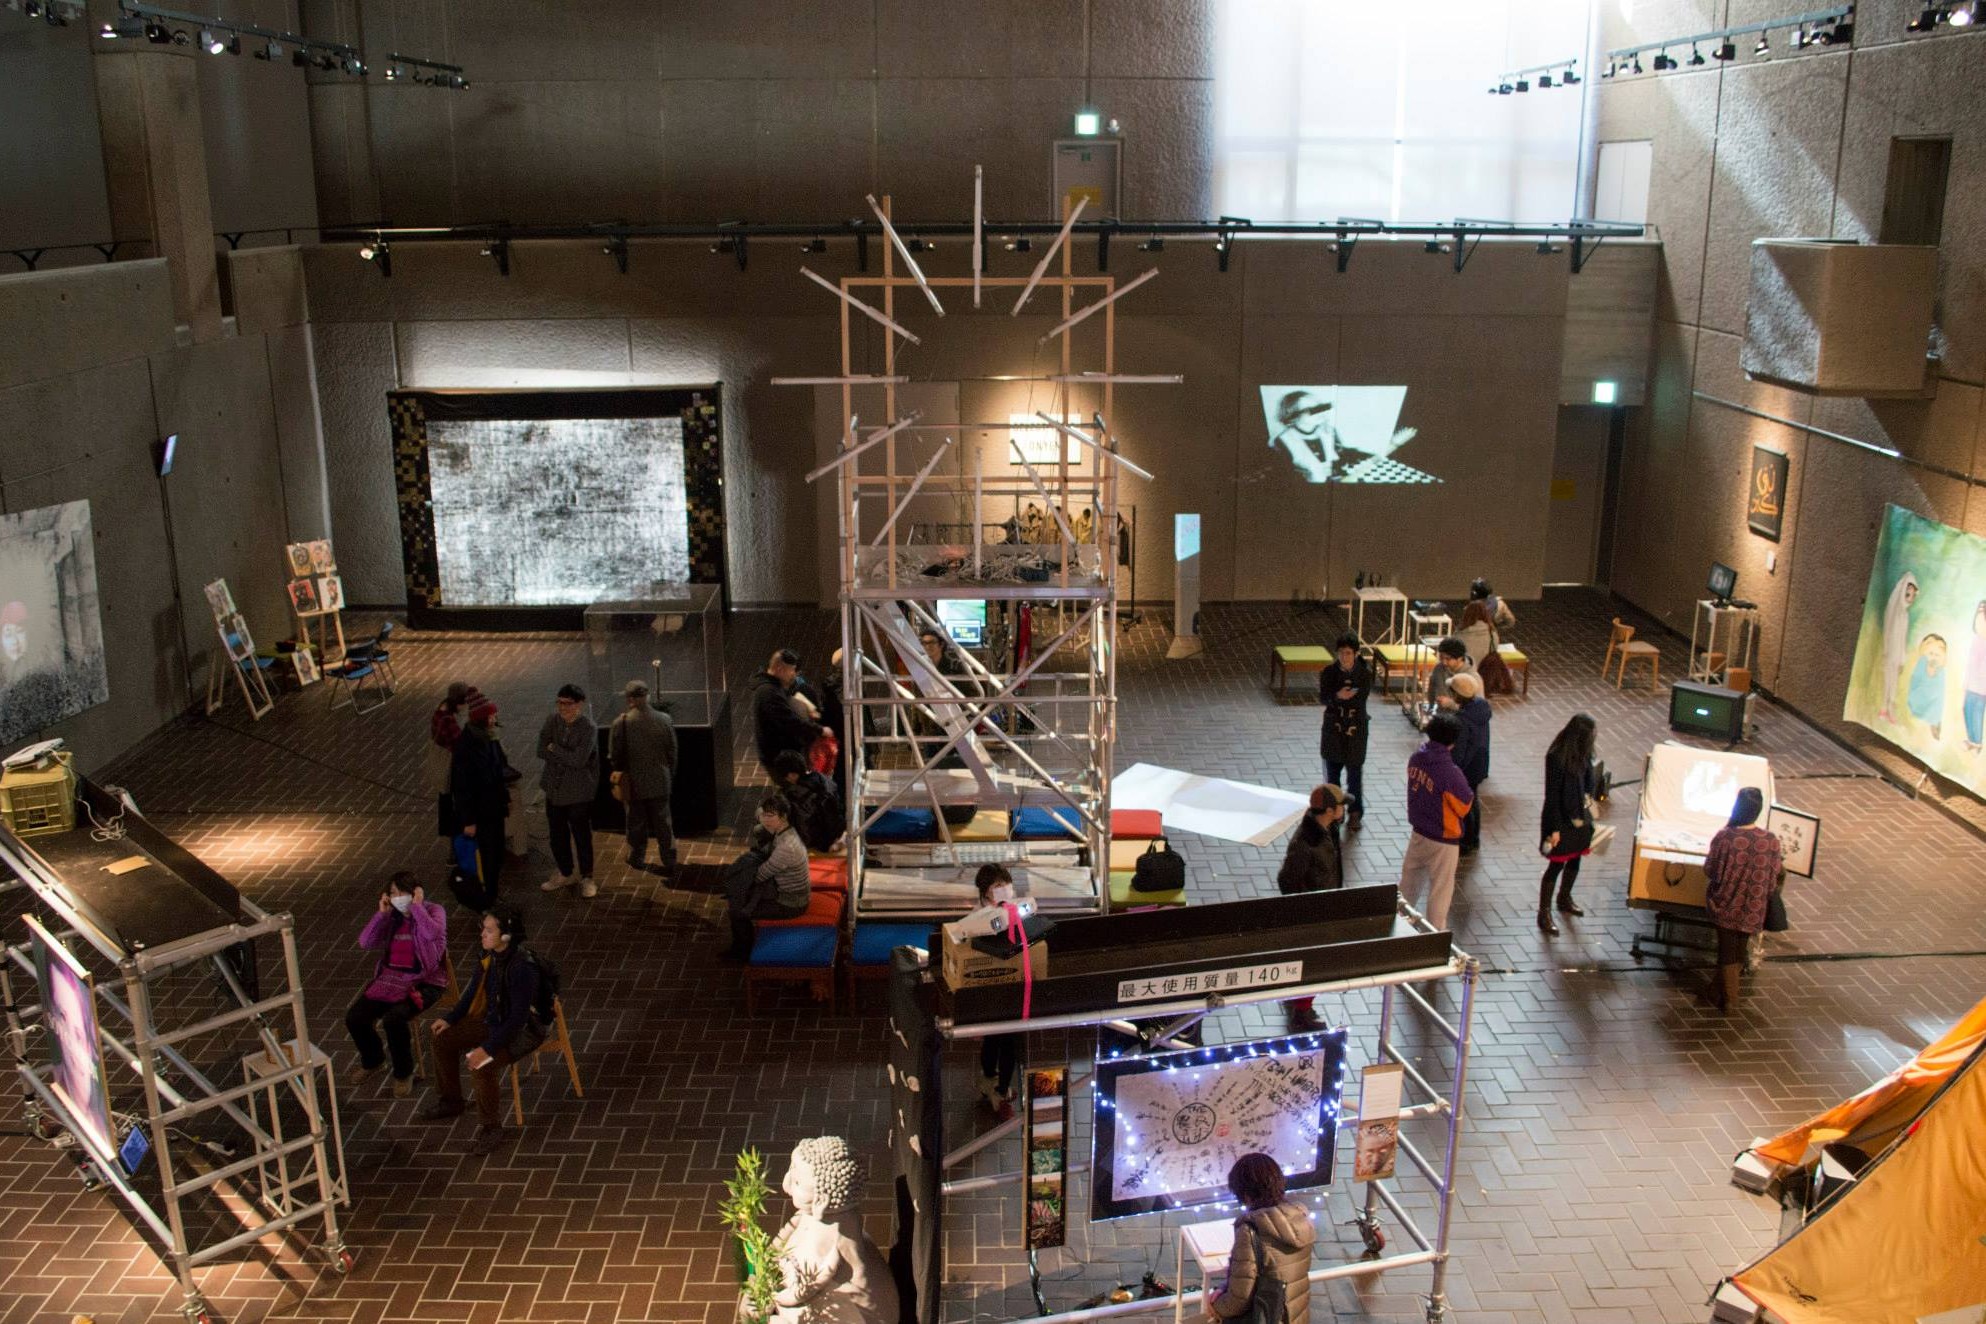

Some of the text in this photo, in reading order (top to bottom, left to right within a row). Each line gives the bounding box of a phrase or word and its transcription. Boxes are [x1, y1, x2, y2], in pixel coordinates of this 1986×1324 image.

[1120, 966, 1297, 998] 最大使用質量 140 kg
